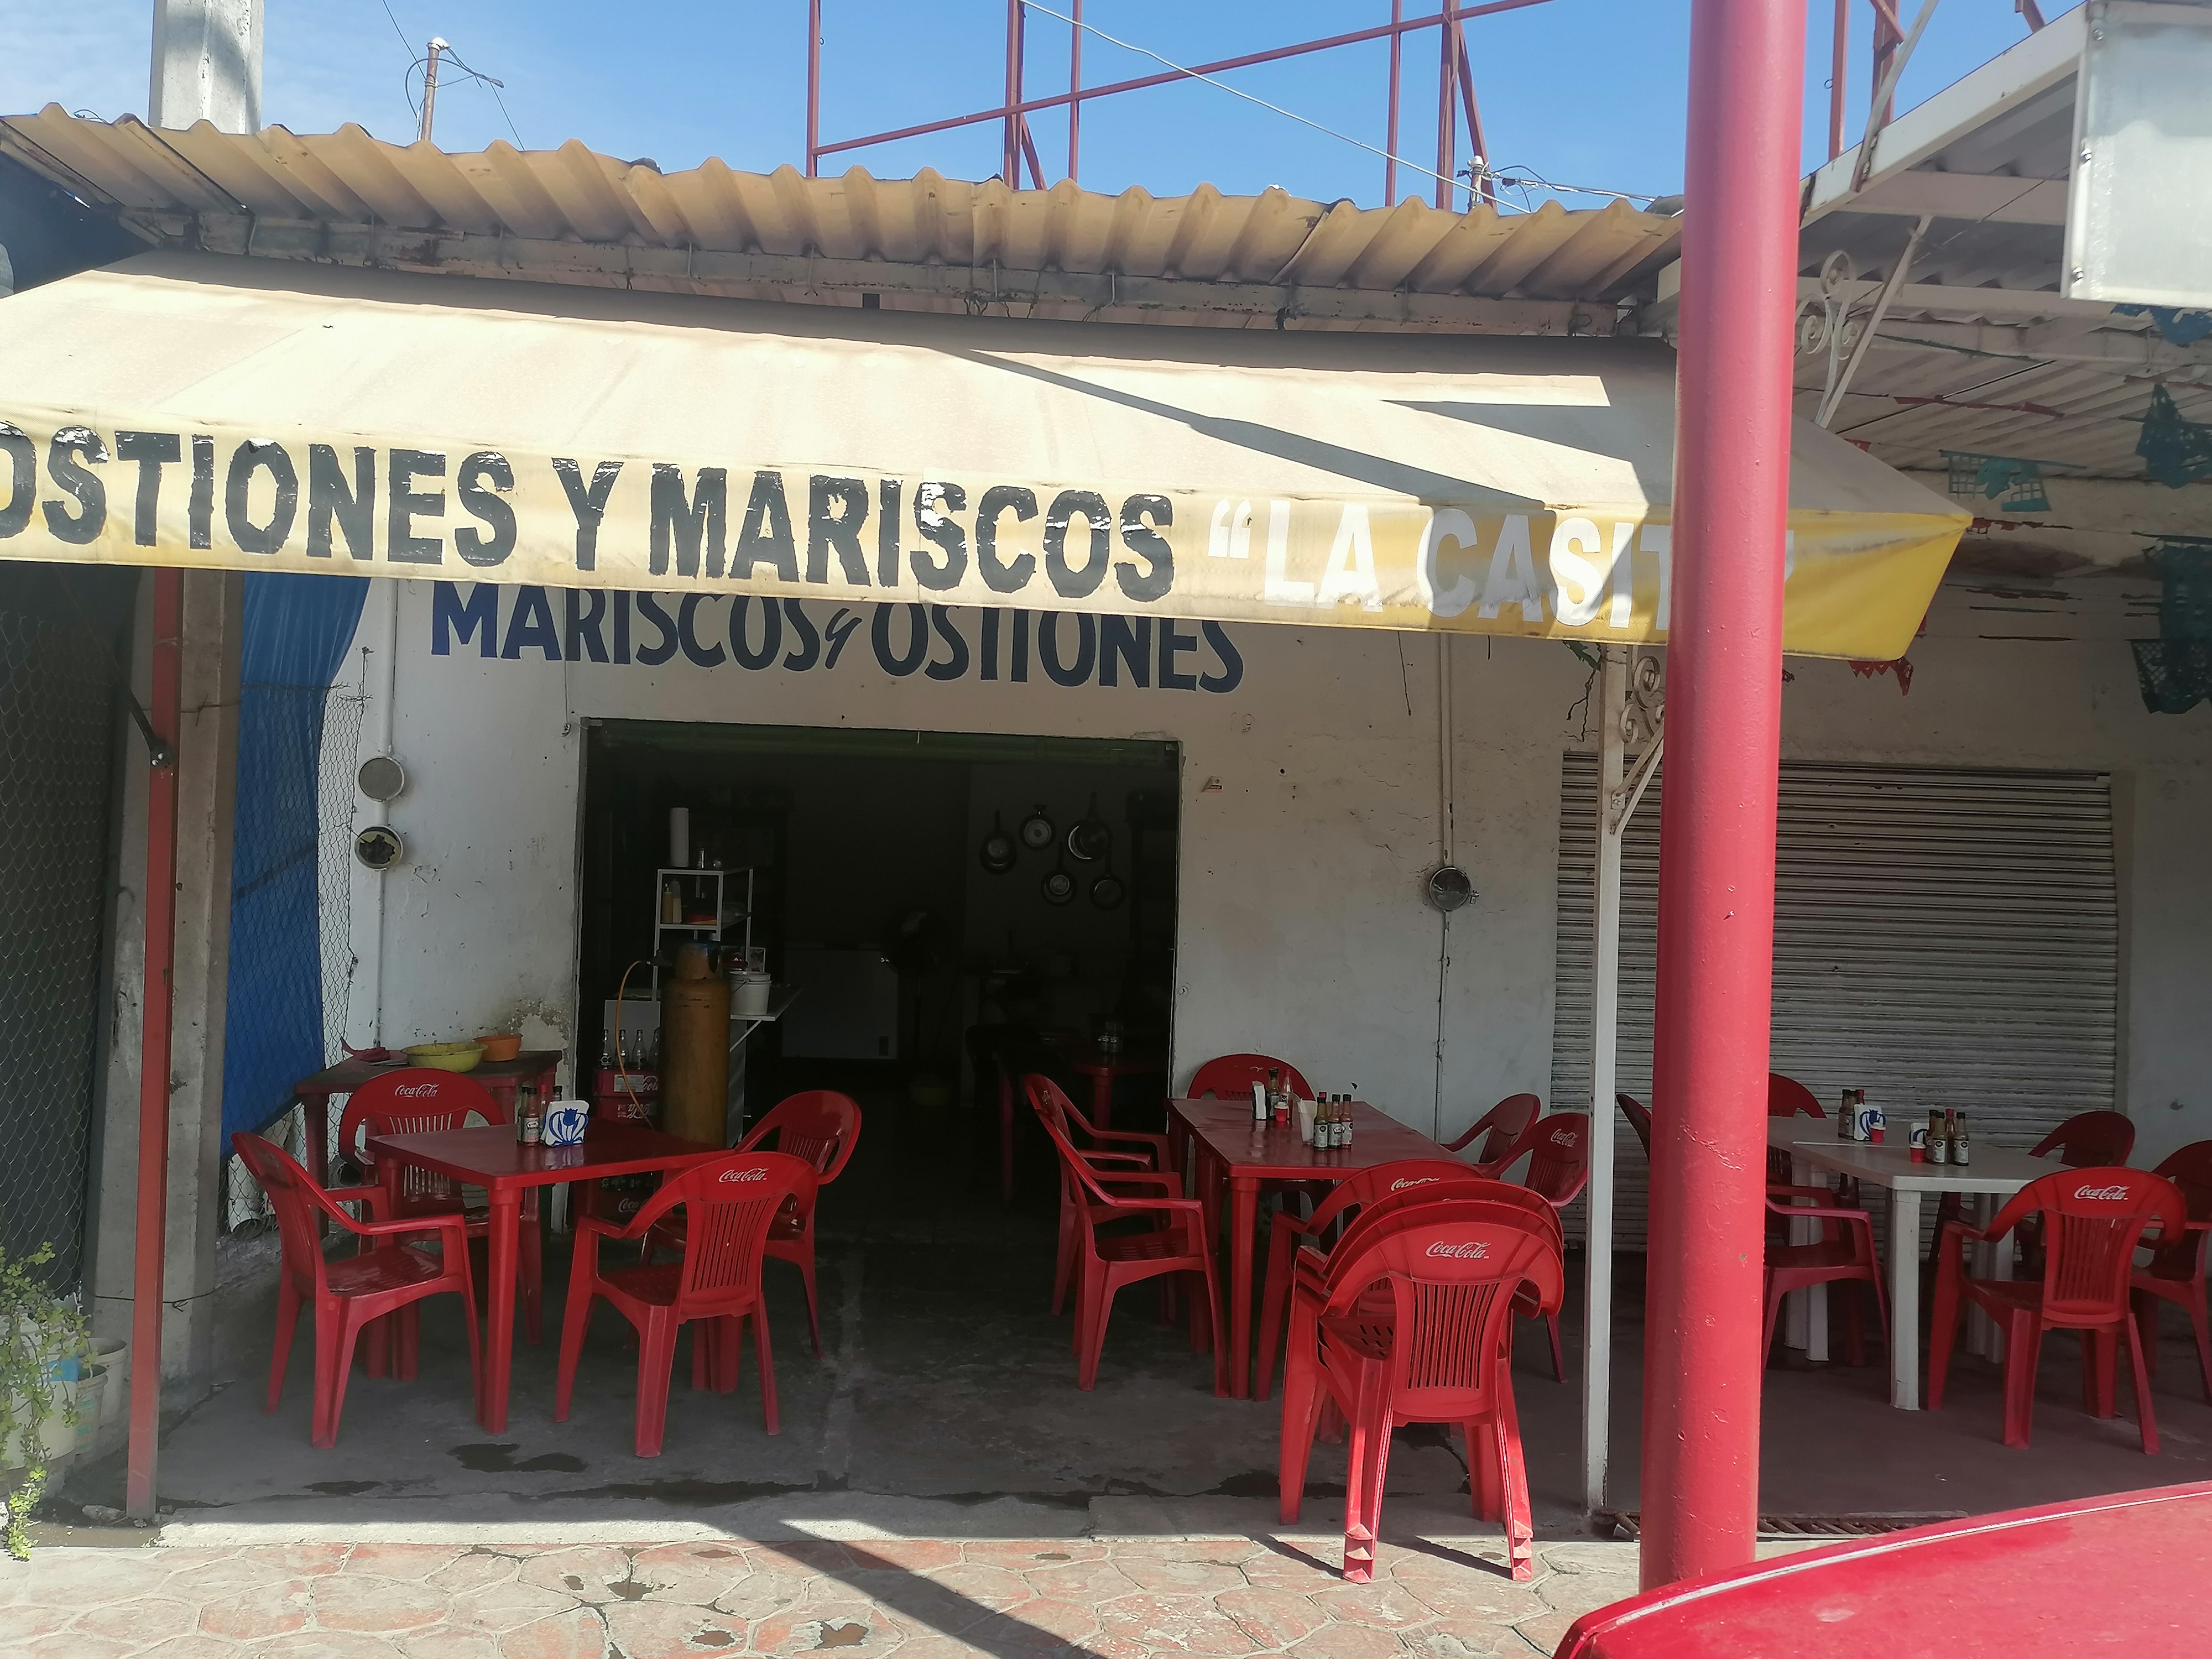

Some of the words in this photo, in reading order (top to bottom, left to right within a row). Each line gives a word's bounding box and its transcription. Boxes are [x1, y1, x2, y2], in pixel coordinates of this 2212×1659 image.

[552, 458, 623, 571] Y
[649, 462, 1174, 602] MARISCOS
[1416, 508, 1670, 631] CASI
[431, 581, 820, 672] MARISCOS
[719, 1168, 769, 1182] Coca-Cola
[2074, 1185, 2131, 1200] Coca-Cola
[1426, 1241, 1491, 1259] Coca-Cola
